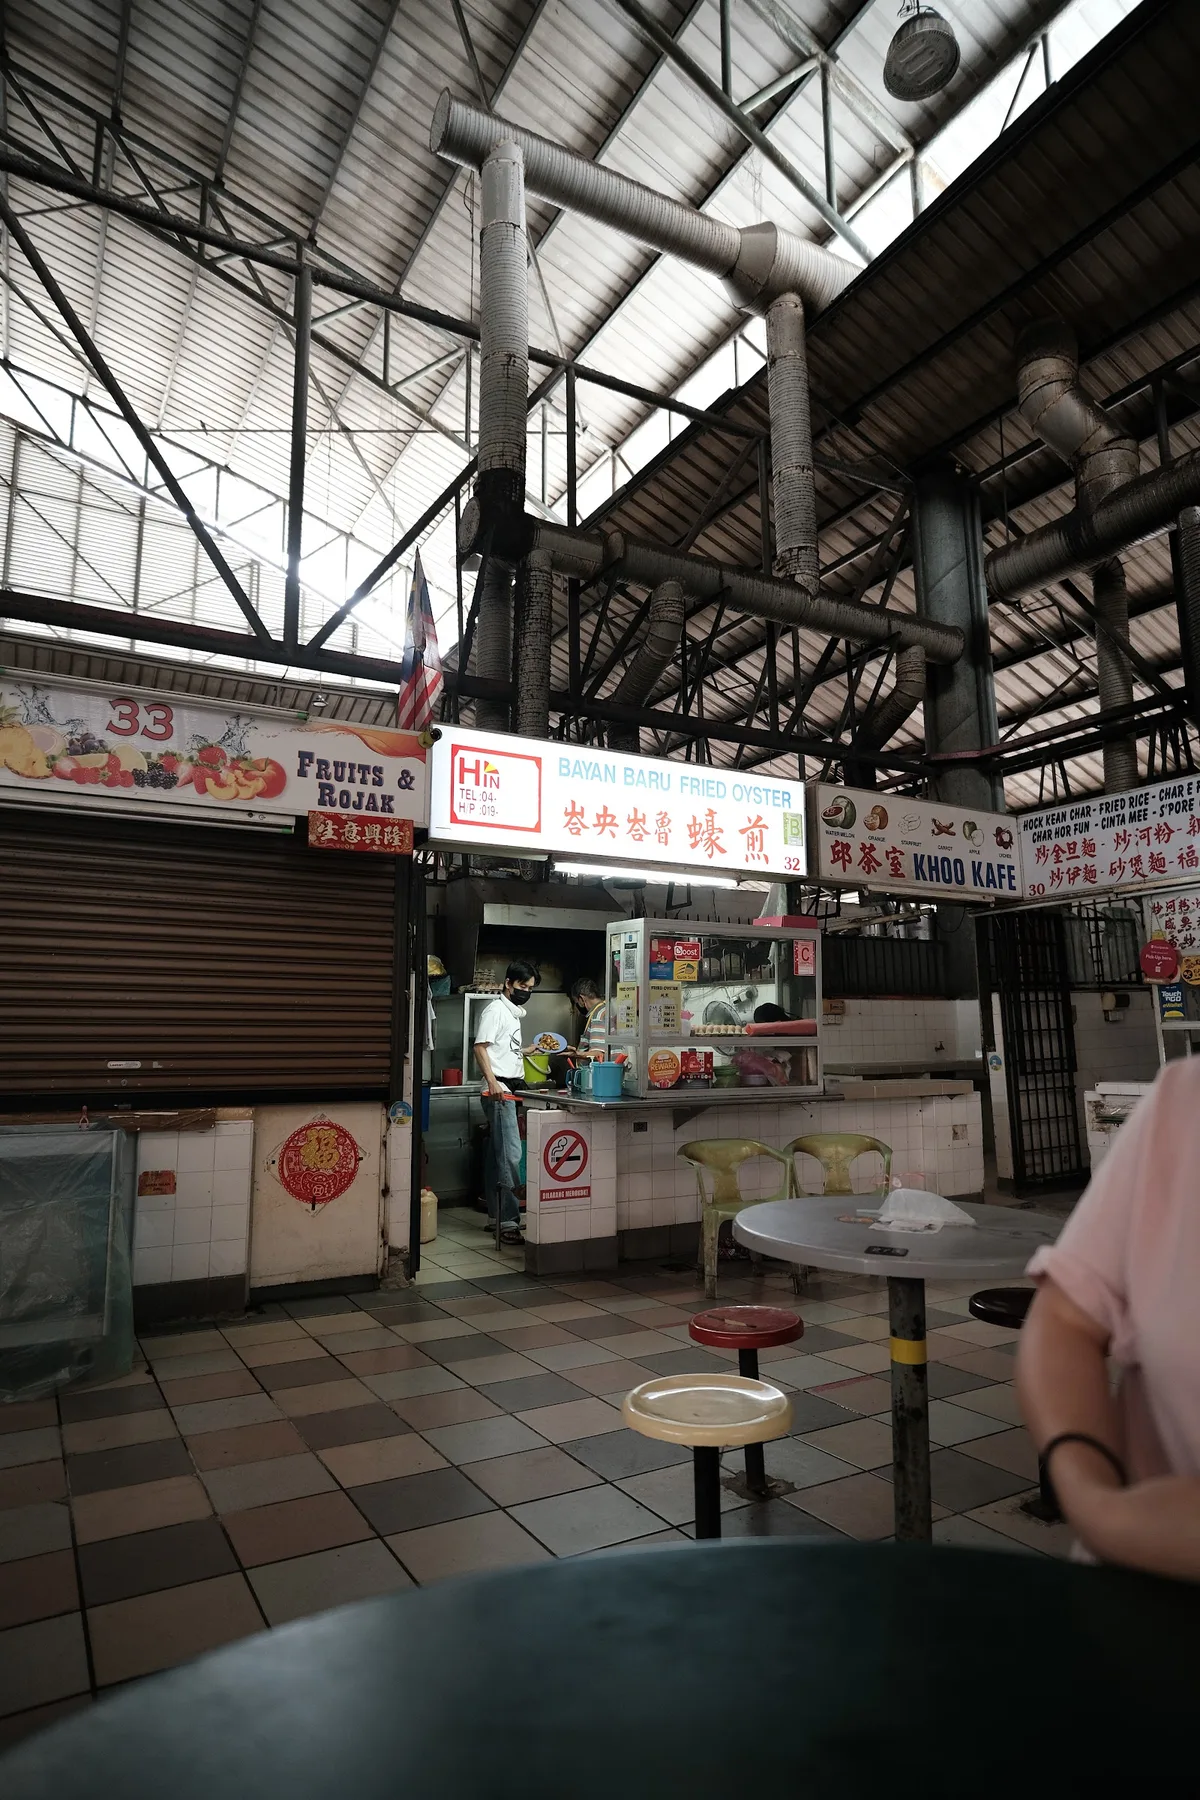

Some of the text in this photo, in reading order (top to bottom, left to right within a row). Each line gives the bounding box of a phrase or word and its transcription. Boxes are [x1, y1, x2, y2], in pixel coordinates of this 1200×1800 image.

[106, 699, 174, 741] 33
[297, 750, 416, 791] FRUITS &
[558, 757, 792, 809] BAYAN BARU FRIED OYSTER
[317, 782, 395, 814] ROJAK
[459, 788, 477, 801] TEL
[1023, 817, 1044, 831] HOCK
[1045, 810, 1067, 826] KEAN
[1099, 798, 1126, 815] FRIED
[1128, 792, 1150, 809] RICE
[1158, 783, 1185, 802] CHAR
[316, 819, 405, 847] 生意興隆
[1032, 831, 1053, 844] CHAR
[1054, 826, 1072, 838] HOR
[1073, 821, 1090, 835] FUN
[1101, 814, 1126, 830] CINTA
[1128, 808, 1148, 824] MEE
[1113, 821, 1175, 855] 炒河粉
[784, 856, 801, 871] 32
[830, 839, 906, 878] 邱茶室
[913, 853, 1017, 891] KHOO KAFE
[1028, 883, 1046, 896] 30
[801, 947, 810, 961] C
